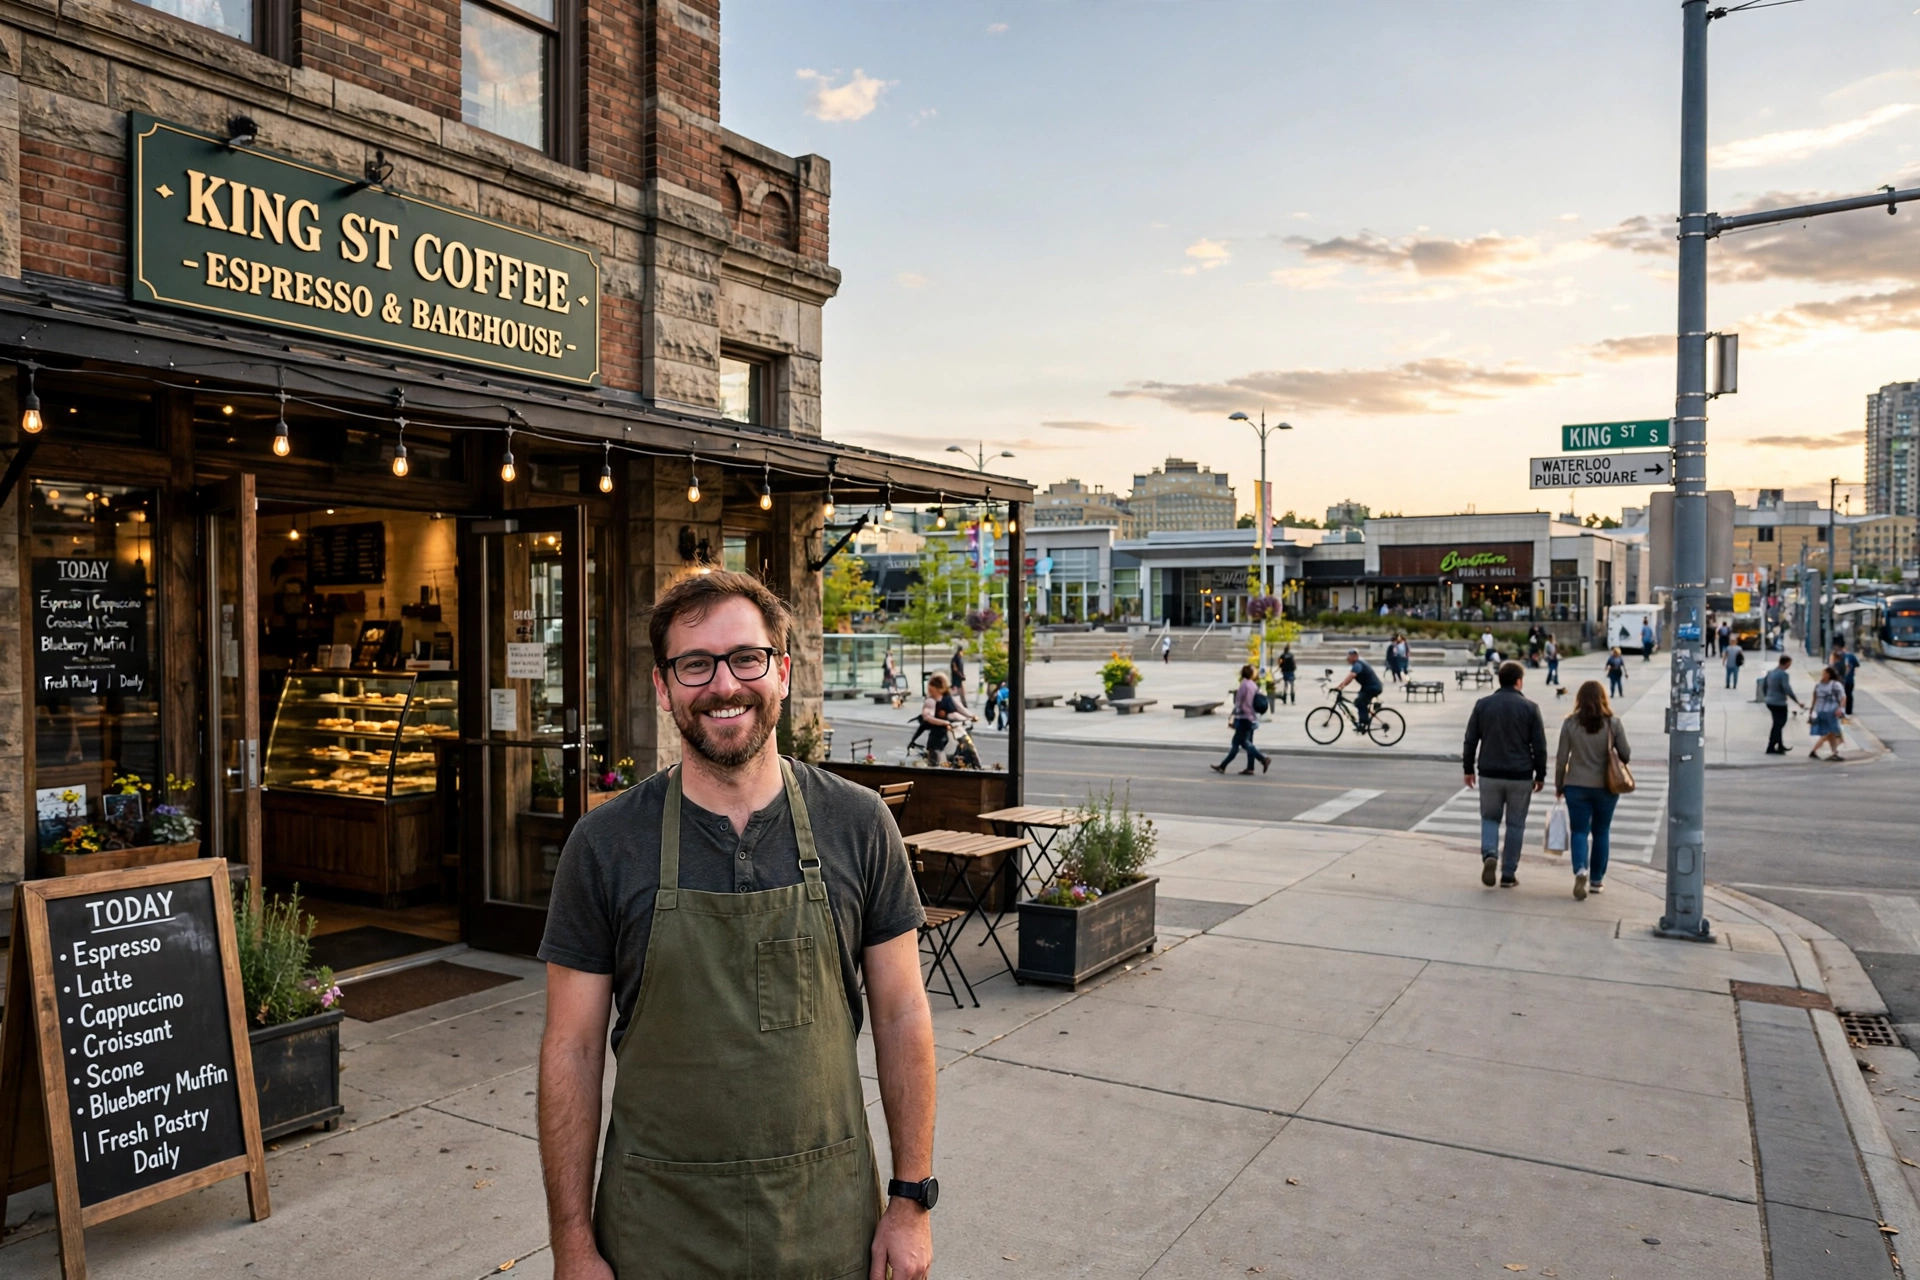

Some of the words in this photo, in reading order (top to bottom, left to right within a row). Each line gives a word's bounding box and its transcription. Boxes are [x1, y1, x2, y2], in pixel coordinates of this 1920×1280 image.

[187, 169, 323, 252] KING
[341, 212, 399, 271] ST
[414, 233, 571, 315] COFFEE
[206, 251, 374, 318] ESPRESSO
[381, 292, 403, 325] &
[412, 297, 563, 359] BAKEHOUSE
[1569, 426, 1611, 447] KING
[1620, 424, 1637, 439] ST
[1649, 429, 1659, 443] S
[1535, 472, 1581, 486] PUBLIC
[1585, 470, 1638, 484] SQUARE
[1542, 457, 1611, 472] WATERLOO
[57, 560, 109, 580] TODAY
[44, 674, 69, 690] Fresh
[85, 890, 174, 927] TODAY
[73, 937, 162, 969] Espresso
[76, 971, 133, 998] Latte
[80, 993, 184, 1030] Cappuccino
[83, 1020, 174, 1058] Croissant
[86, 1061, 145, 1088] Scone
[89, 1084, 171, 1119] Blueberry
[175, 1063, 229, 1094] Muffin
[98, 1121, 149, 1154] Fresh
[154, 1109, 210, 1138] Pastry
[133, 1141, 180, 1174] Daily
